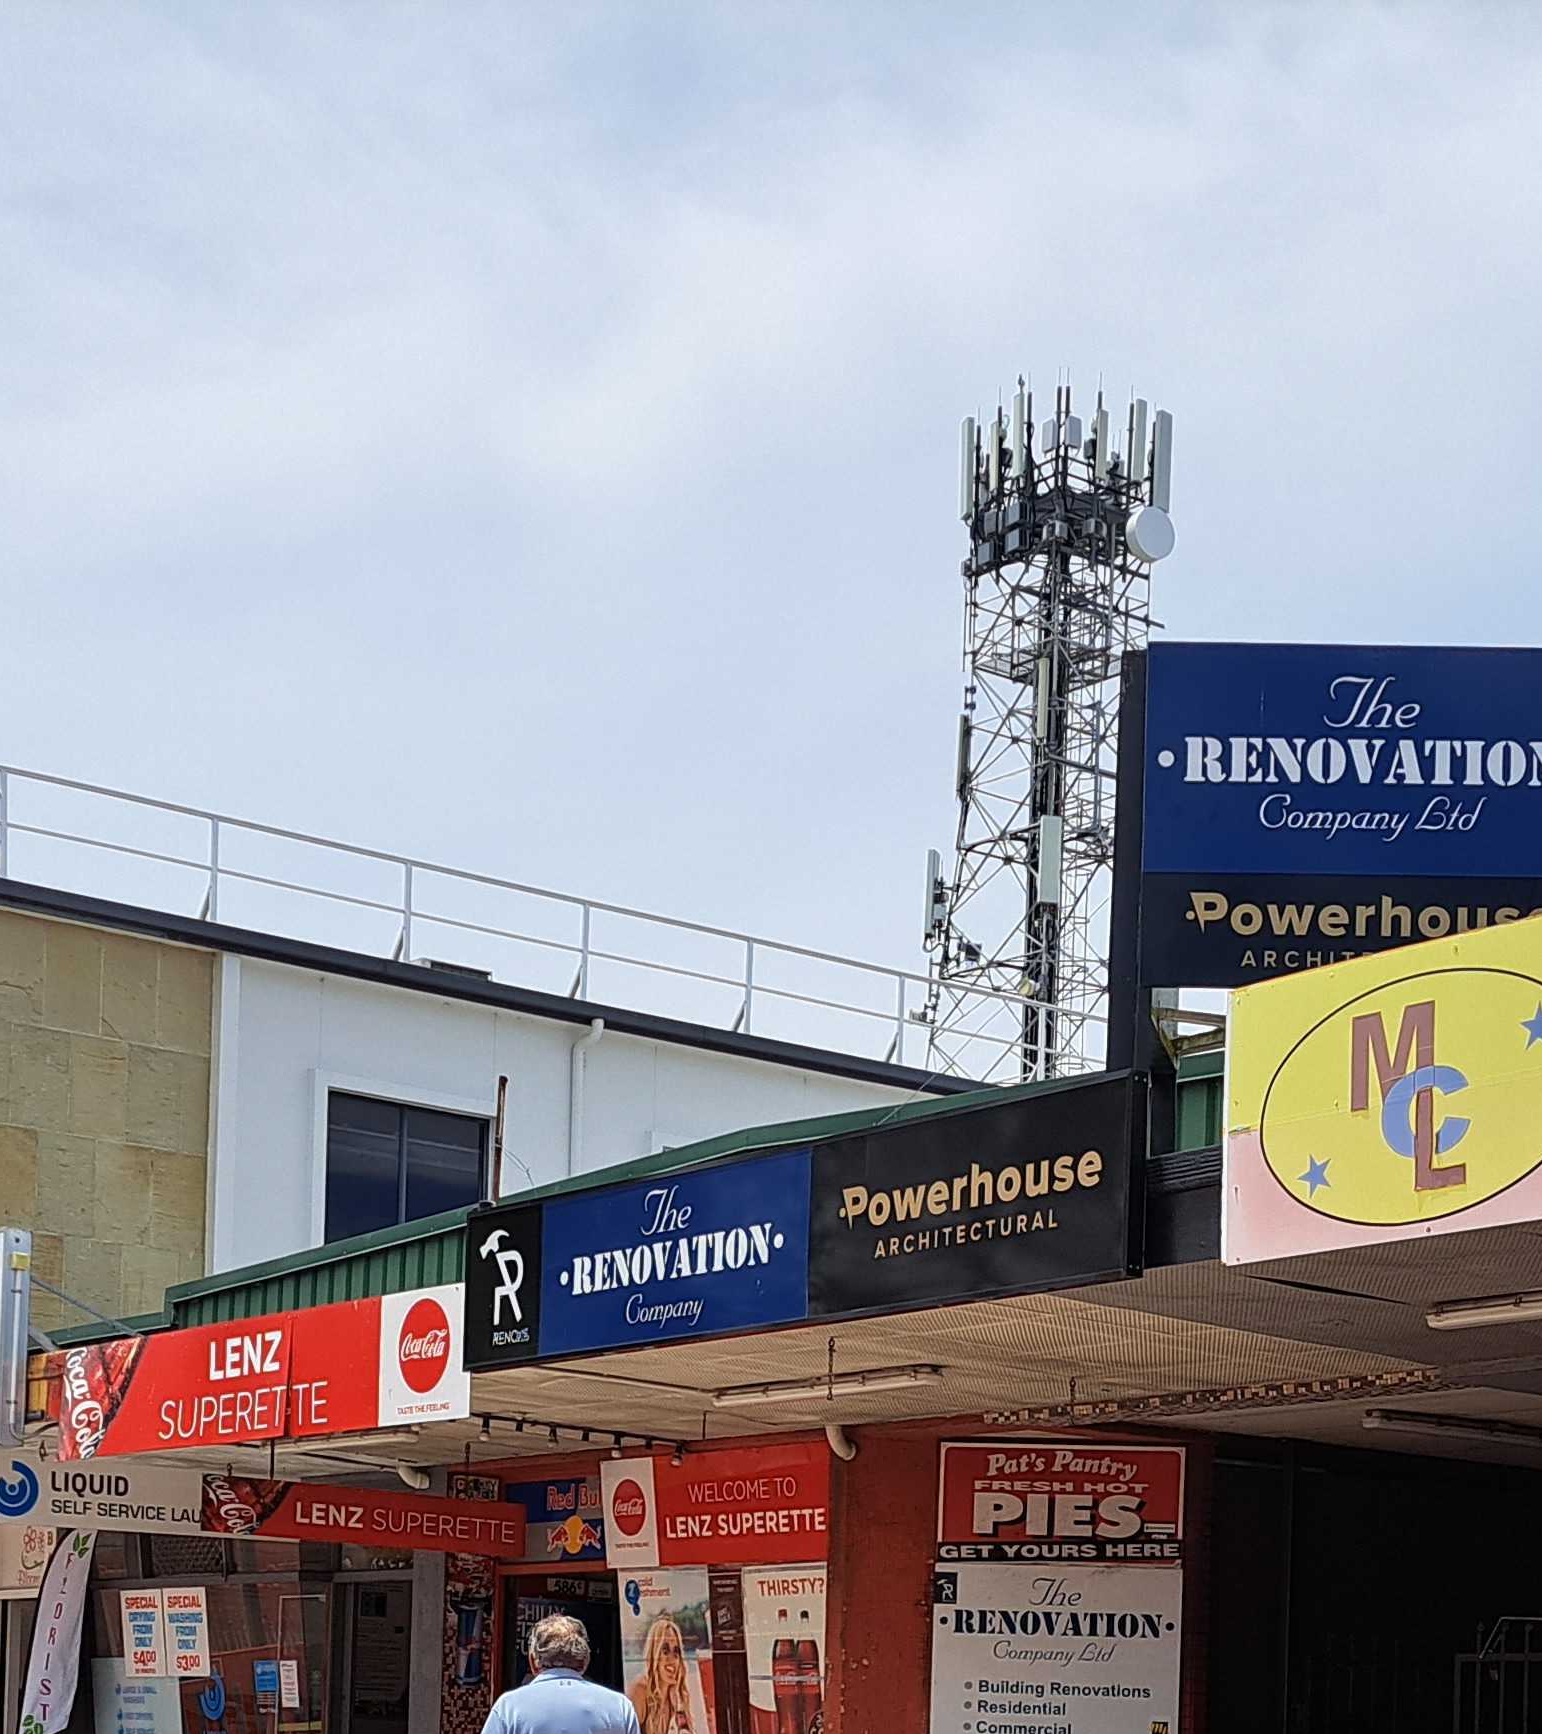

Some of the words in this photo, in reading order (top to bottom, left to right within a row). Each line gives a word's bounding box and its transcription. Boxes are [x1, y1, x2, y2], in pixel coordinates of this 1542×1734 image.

[1323, 676, 1420, 729] The
[1259, 793, 1407, 841] Company
[1415, 796, 1486, 832] Ltd
[839, 1149, 1104, 1229] Powerhouse
[640, 1185, 693, 1236] The
[874, 1209, 1060, 1260] ARCHITECTURAL
[570, 1222, 773, 1297] RENOVATION
[625, 1293, 705, 1330] Company
[209, 1330, 282, 1381] LENZ
[159, 1381, 328, 1441] SUPERETTE
[987, 1453, 1046, 1477] Pat's
[1052, 1450, 1137, 1481] Pantry
[51, 1470, 129, 1497] LIQUID
[688, 1479, 770, 1503] WELCOME
[774, 1477, 796, 1497] TO
[974, 1480, 1074, 1492] FRESH
[1083, 1483, 1149, 1493] HOT
[51, 1498, 93, 1515] SELF
[98, 1501, 166, 1520] SERVICE
[547, 1486, 575, 1511] Red
[295, 1502, 364, 1528] LENZ
[373, 1503, 516, 1544] SUPERETTE
[665, 1515, 713, 1538] LENZ
[718, 1508, 826, 1536] SUPERETTE
[973, 1492, 1142, 1539] PIES
[940, 1544, 998, 1559] GET
[1000, 1544, 1098, 1557] YOURS
[1105, 1544, 1180, 1557] HERE
[167, 1595, 202, 1608] SPECIAL
[758, 1577, 824, 1598] THIRSTY?
[1029, 1577, 1083, 1607] The
[125, 1596, 158, 1609] SPECIAL
[132, 1624, 153, 1635] FROM
[168, 1612, 203, 1624] WASHING
[175, 1626, 197, 1637] FROM
[953, 1609, 1164, 1638] RENOVATION
[38, 1552, 76, 1722] FLORIST
[134, 1636, 152, 1648] ONLY
[177, 1638, 197, 1650] ONLY
[992, 1640, 1074, 1668] Company
[1077, 1643, 1118, 1664] Ltd
[978, 1680, 1045, 1698] Building
[1050, 1682, 1151, 1699] Renovations
[977, 1700, 1067, 1716] Residential
